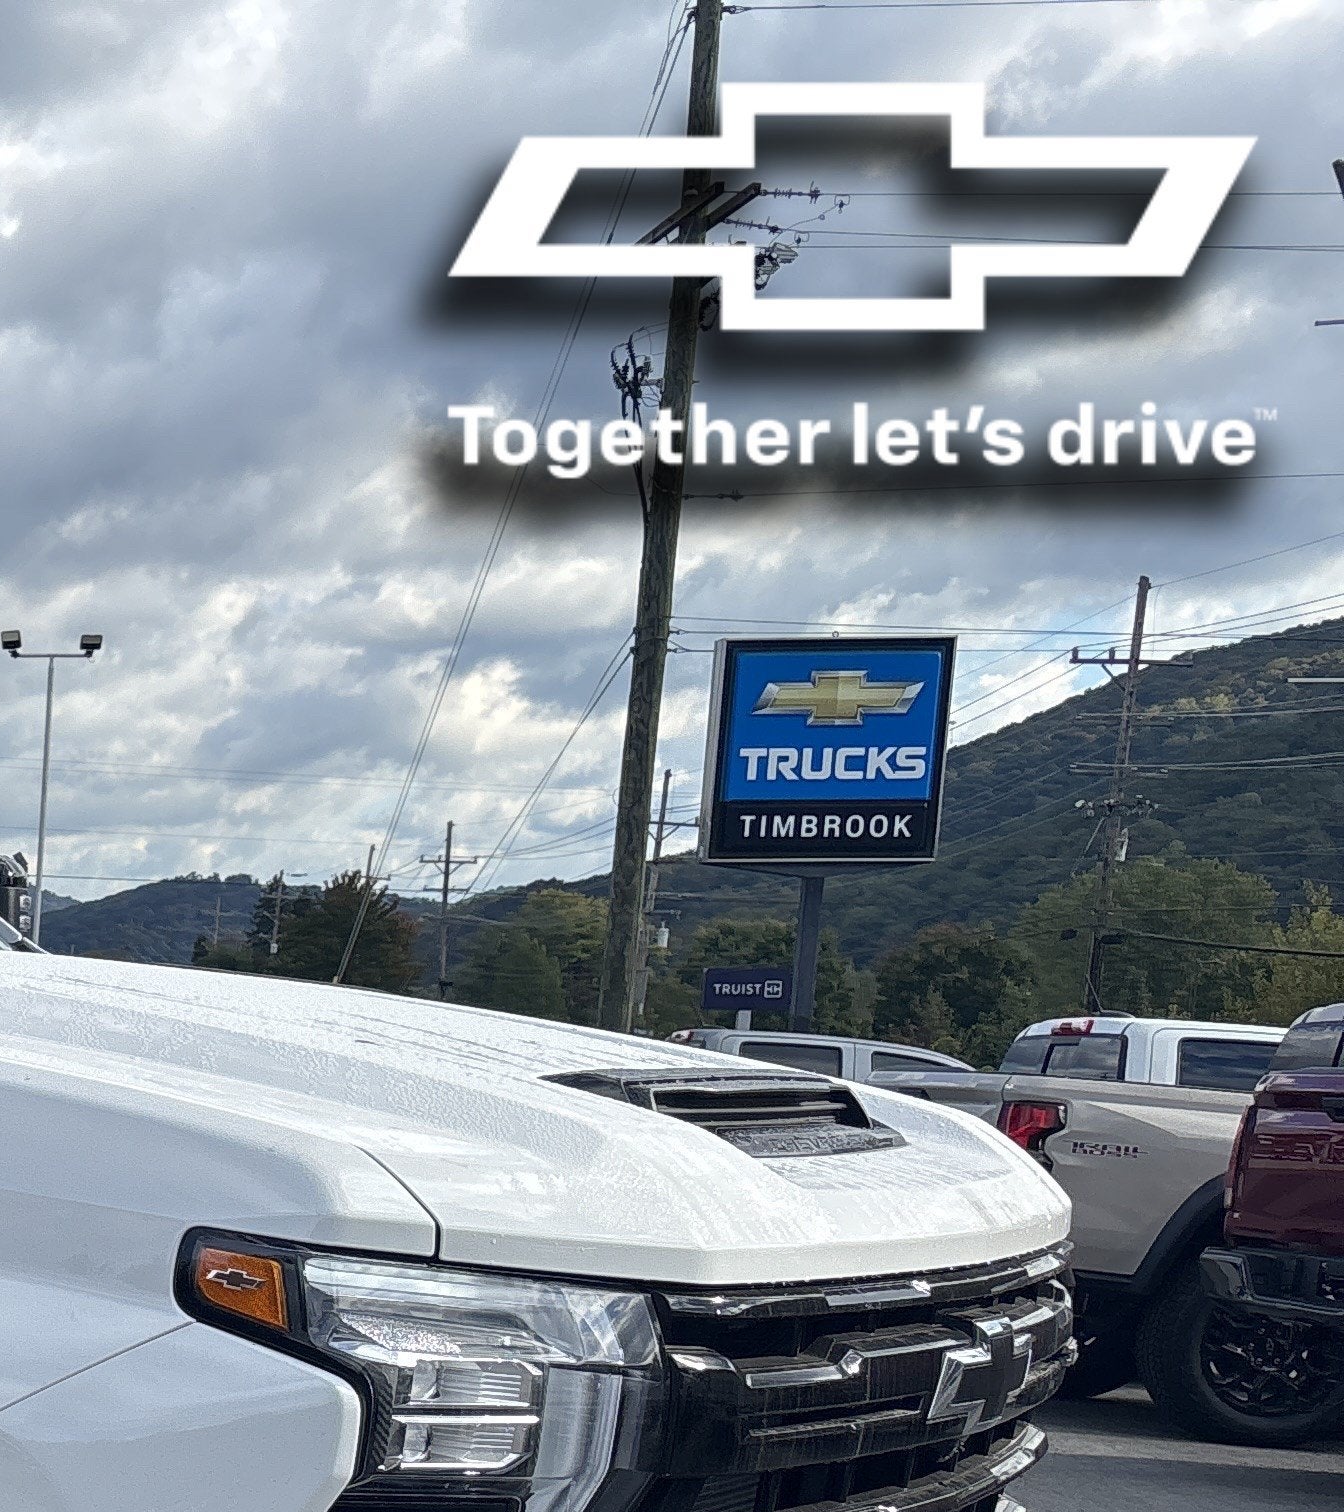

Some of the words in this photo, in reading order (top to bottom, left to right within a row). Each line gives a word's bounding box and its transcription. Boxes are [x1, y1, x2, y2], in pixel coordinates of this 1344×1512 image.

[739, 746, 927, 781] TRUCKS
[740, 814, 913, 838] TIMBROOK
[713, 983, 763, 995] TRUIST
